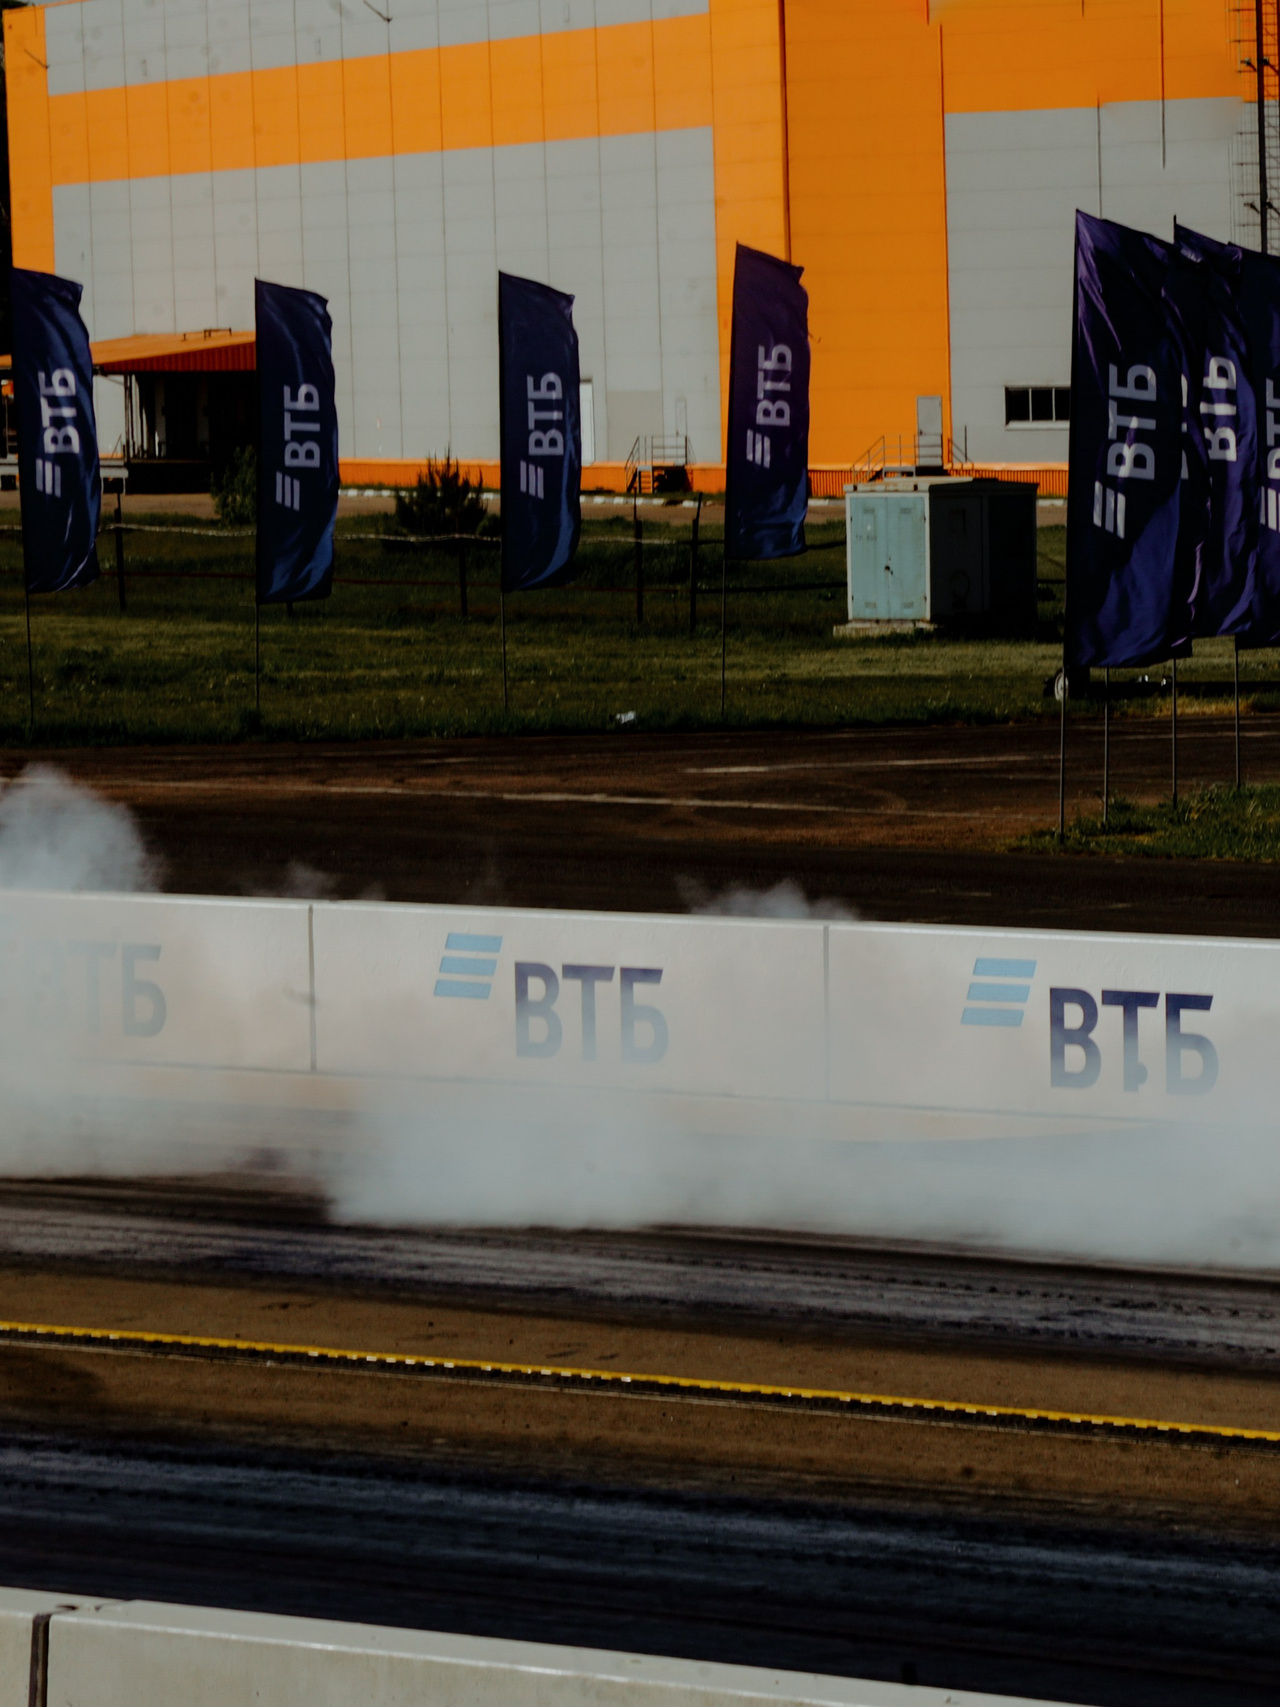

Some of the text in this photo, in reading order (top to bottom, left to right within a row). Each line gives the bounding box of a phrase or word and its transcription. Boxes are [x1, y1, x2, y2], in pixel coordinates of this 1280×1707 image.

[38, 368, 80, 454] ВТБ
[284, 383, 320, 468] ВТБ
[527, 372, 564, 456] ВТБ
[756, 344, 792, 427] ВТБ
[1107, 362, 1157, 480] ВТБ
[40, 939, 167, 1038] ТБ
[514, 962, 669, 1064] ВТБ
[1049, 987, 1218, 1095] ВТБ
